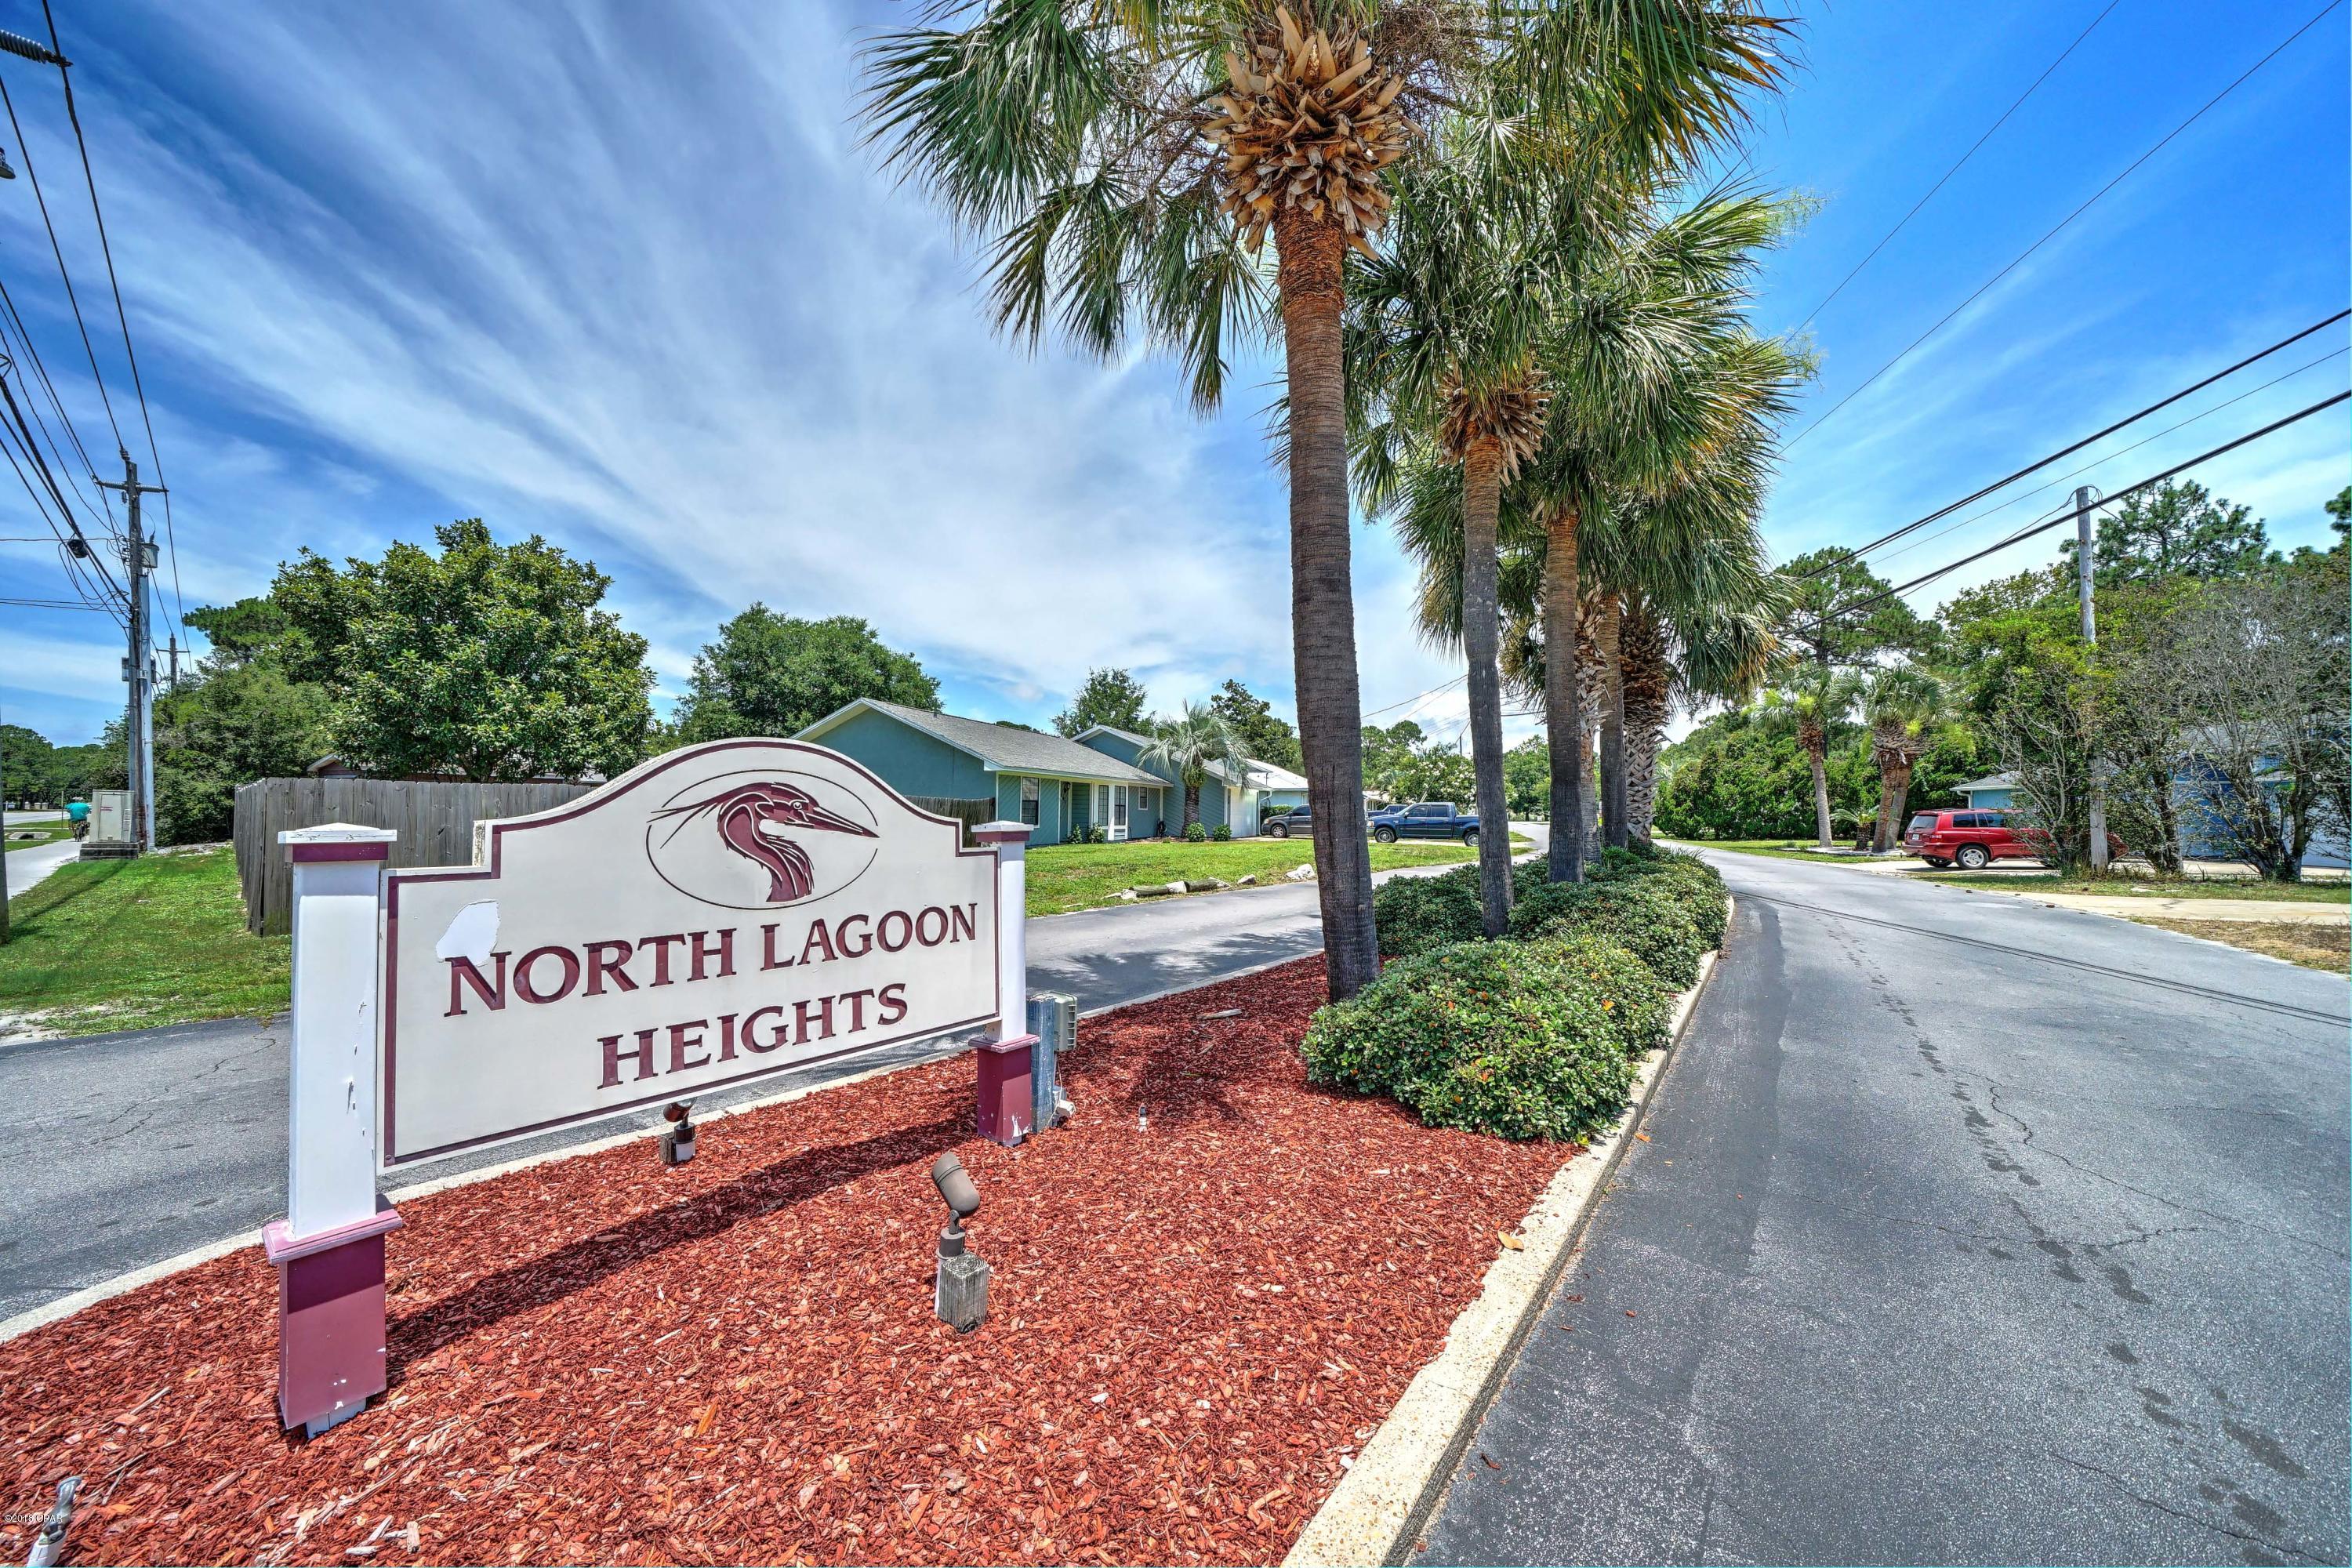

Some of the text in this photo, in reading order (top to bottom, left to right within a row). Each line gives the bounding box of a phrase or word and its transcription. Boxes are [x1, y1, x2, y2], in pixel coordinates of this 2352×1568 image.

[444, 902, 978, 1017] NORTH LAGOON
[597, 983, 908, 1089] HEIGHTS
